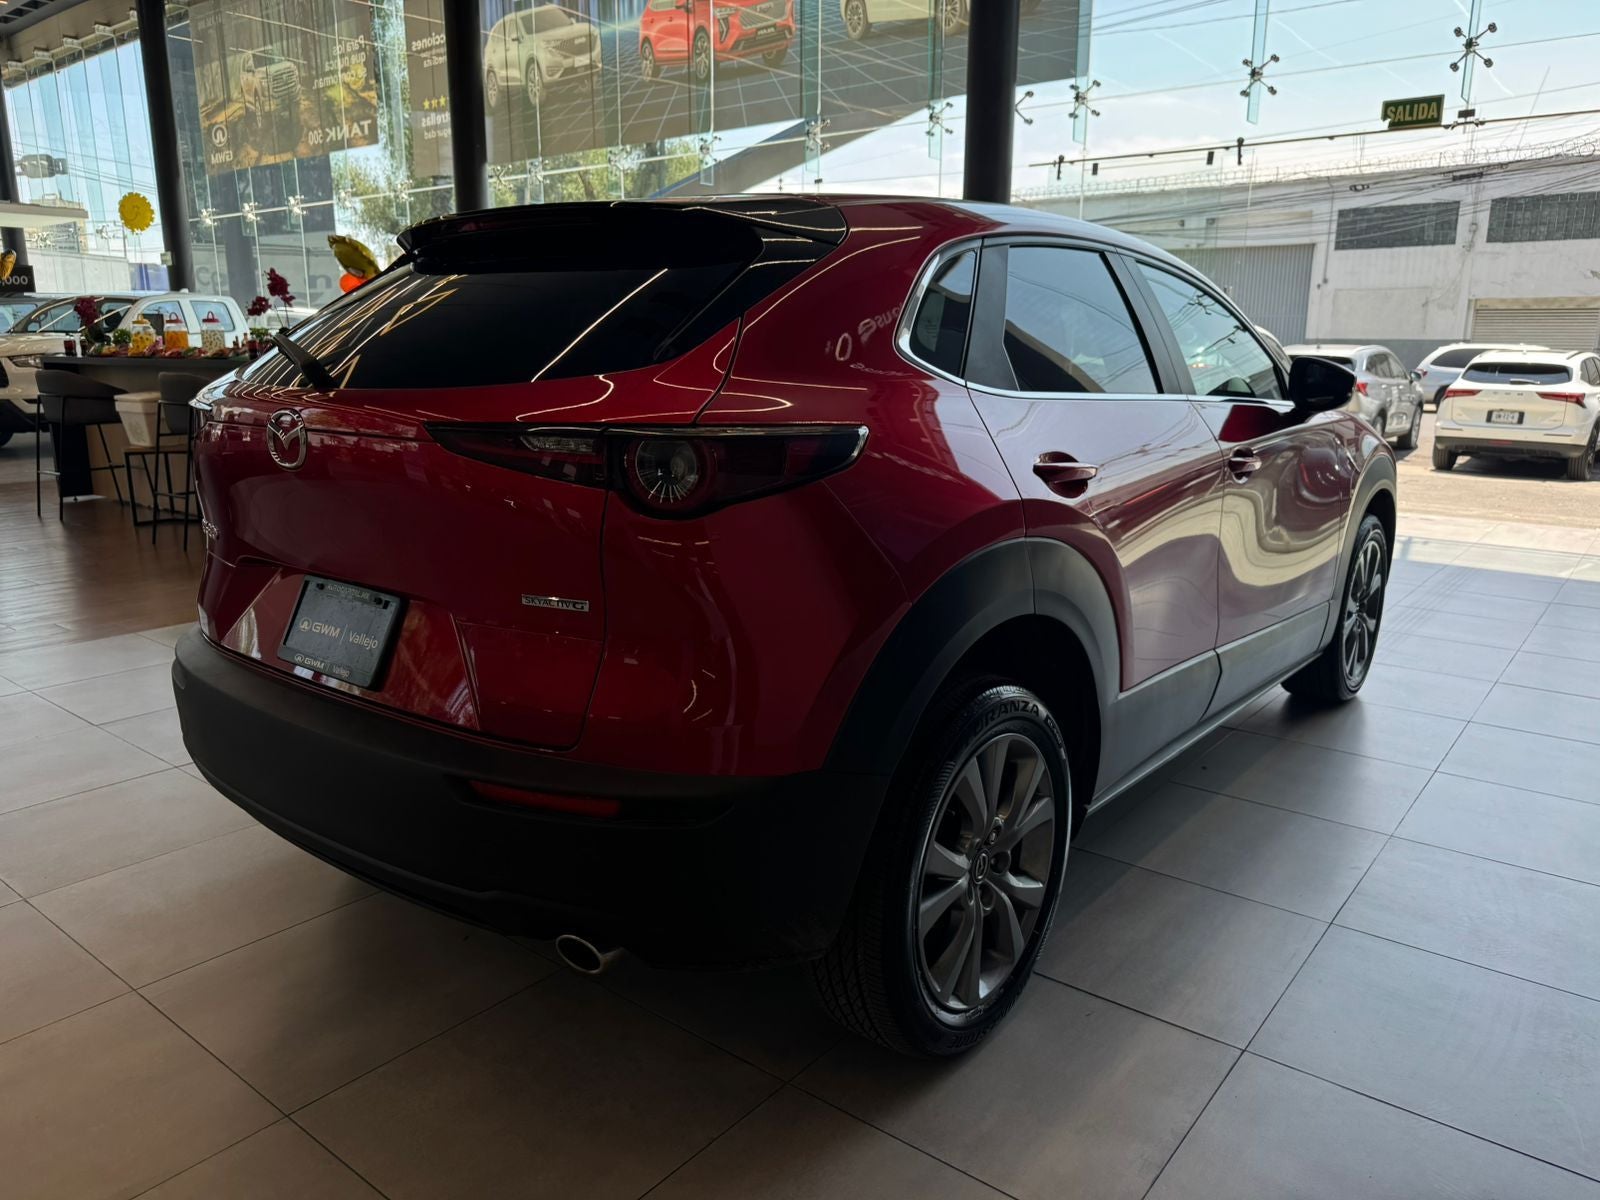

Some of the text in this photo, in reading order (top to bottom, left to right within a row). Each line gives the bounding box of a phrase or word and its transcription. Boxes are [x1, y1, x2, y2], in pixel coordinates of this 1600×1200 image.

[1387, 102, 1438, 122] SALIDA
[0, 275, 28, 287] ,000
[312, 622, 379, 650] GWM Vallejo
[304, 657, 325, 670] GWM
